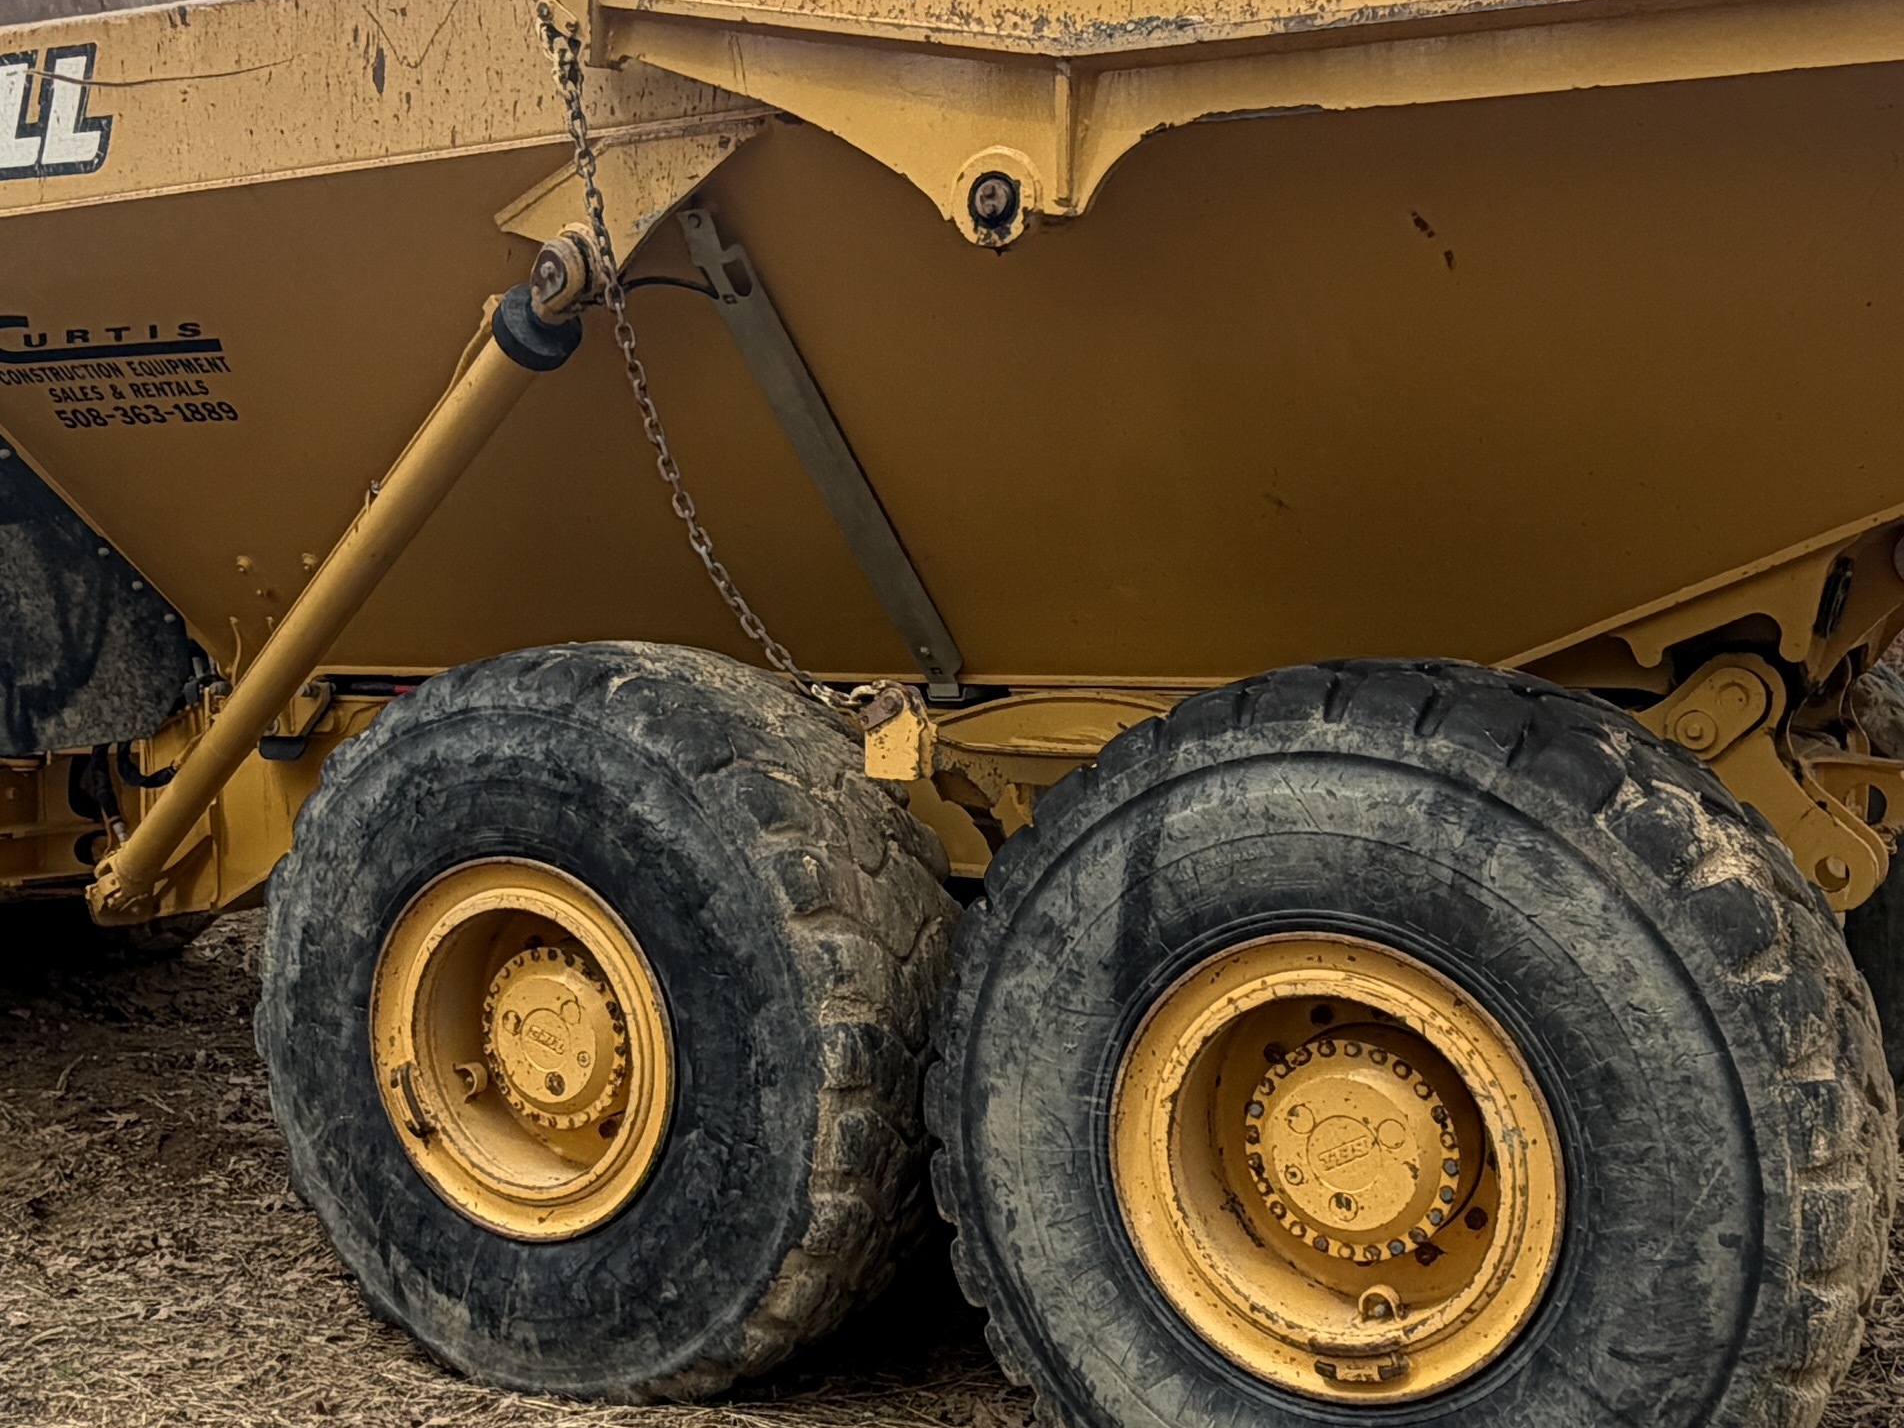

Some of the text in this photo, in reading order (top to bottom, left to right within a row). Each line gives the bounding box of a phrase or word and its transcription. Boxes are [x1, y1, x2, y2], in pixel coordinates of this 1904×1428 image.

[127, 356, 233, 380] EQUIPMENT
[48, 379, 210, 404] SALES & RENTALS
[53, 400, 240, 429] 508-363-1889
